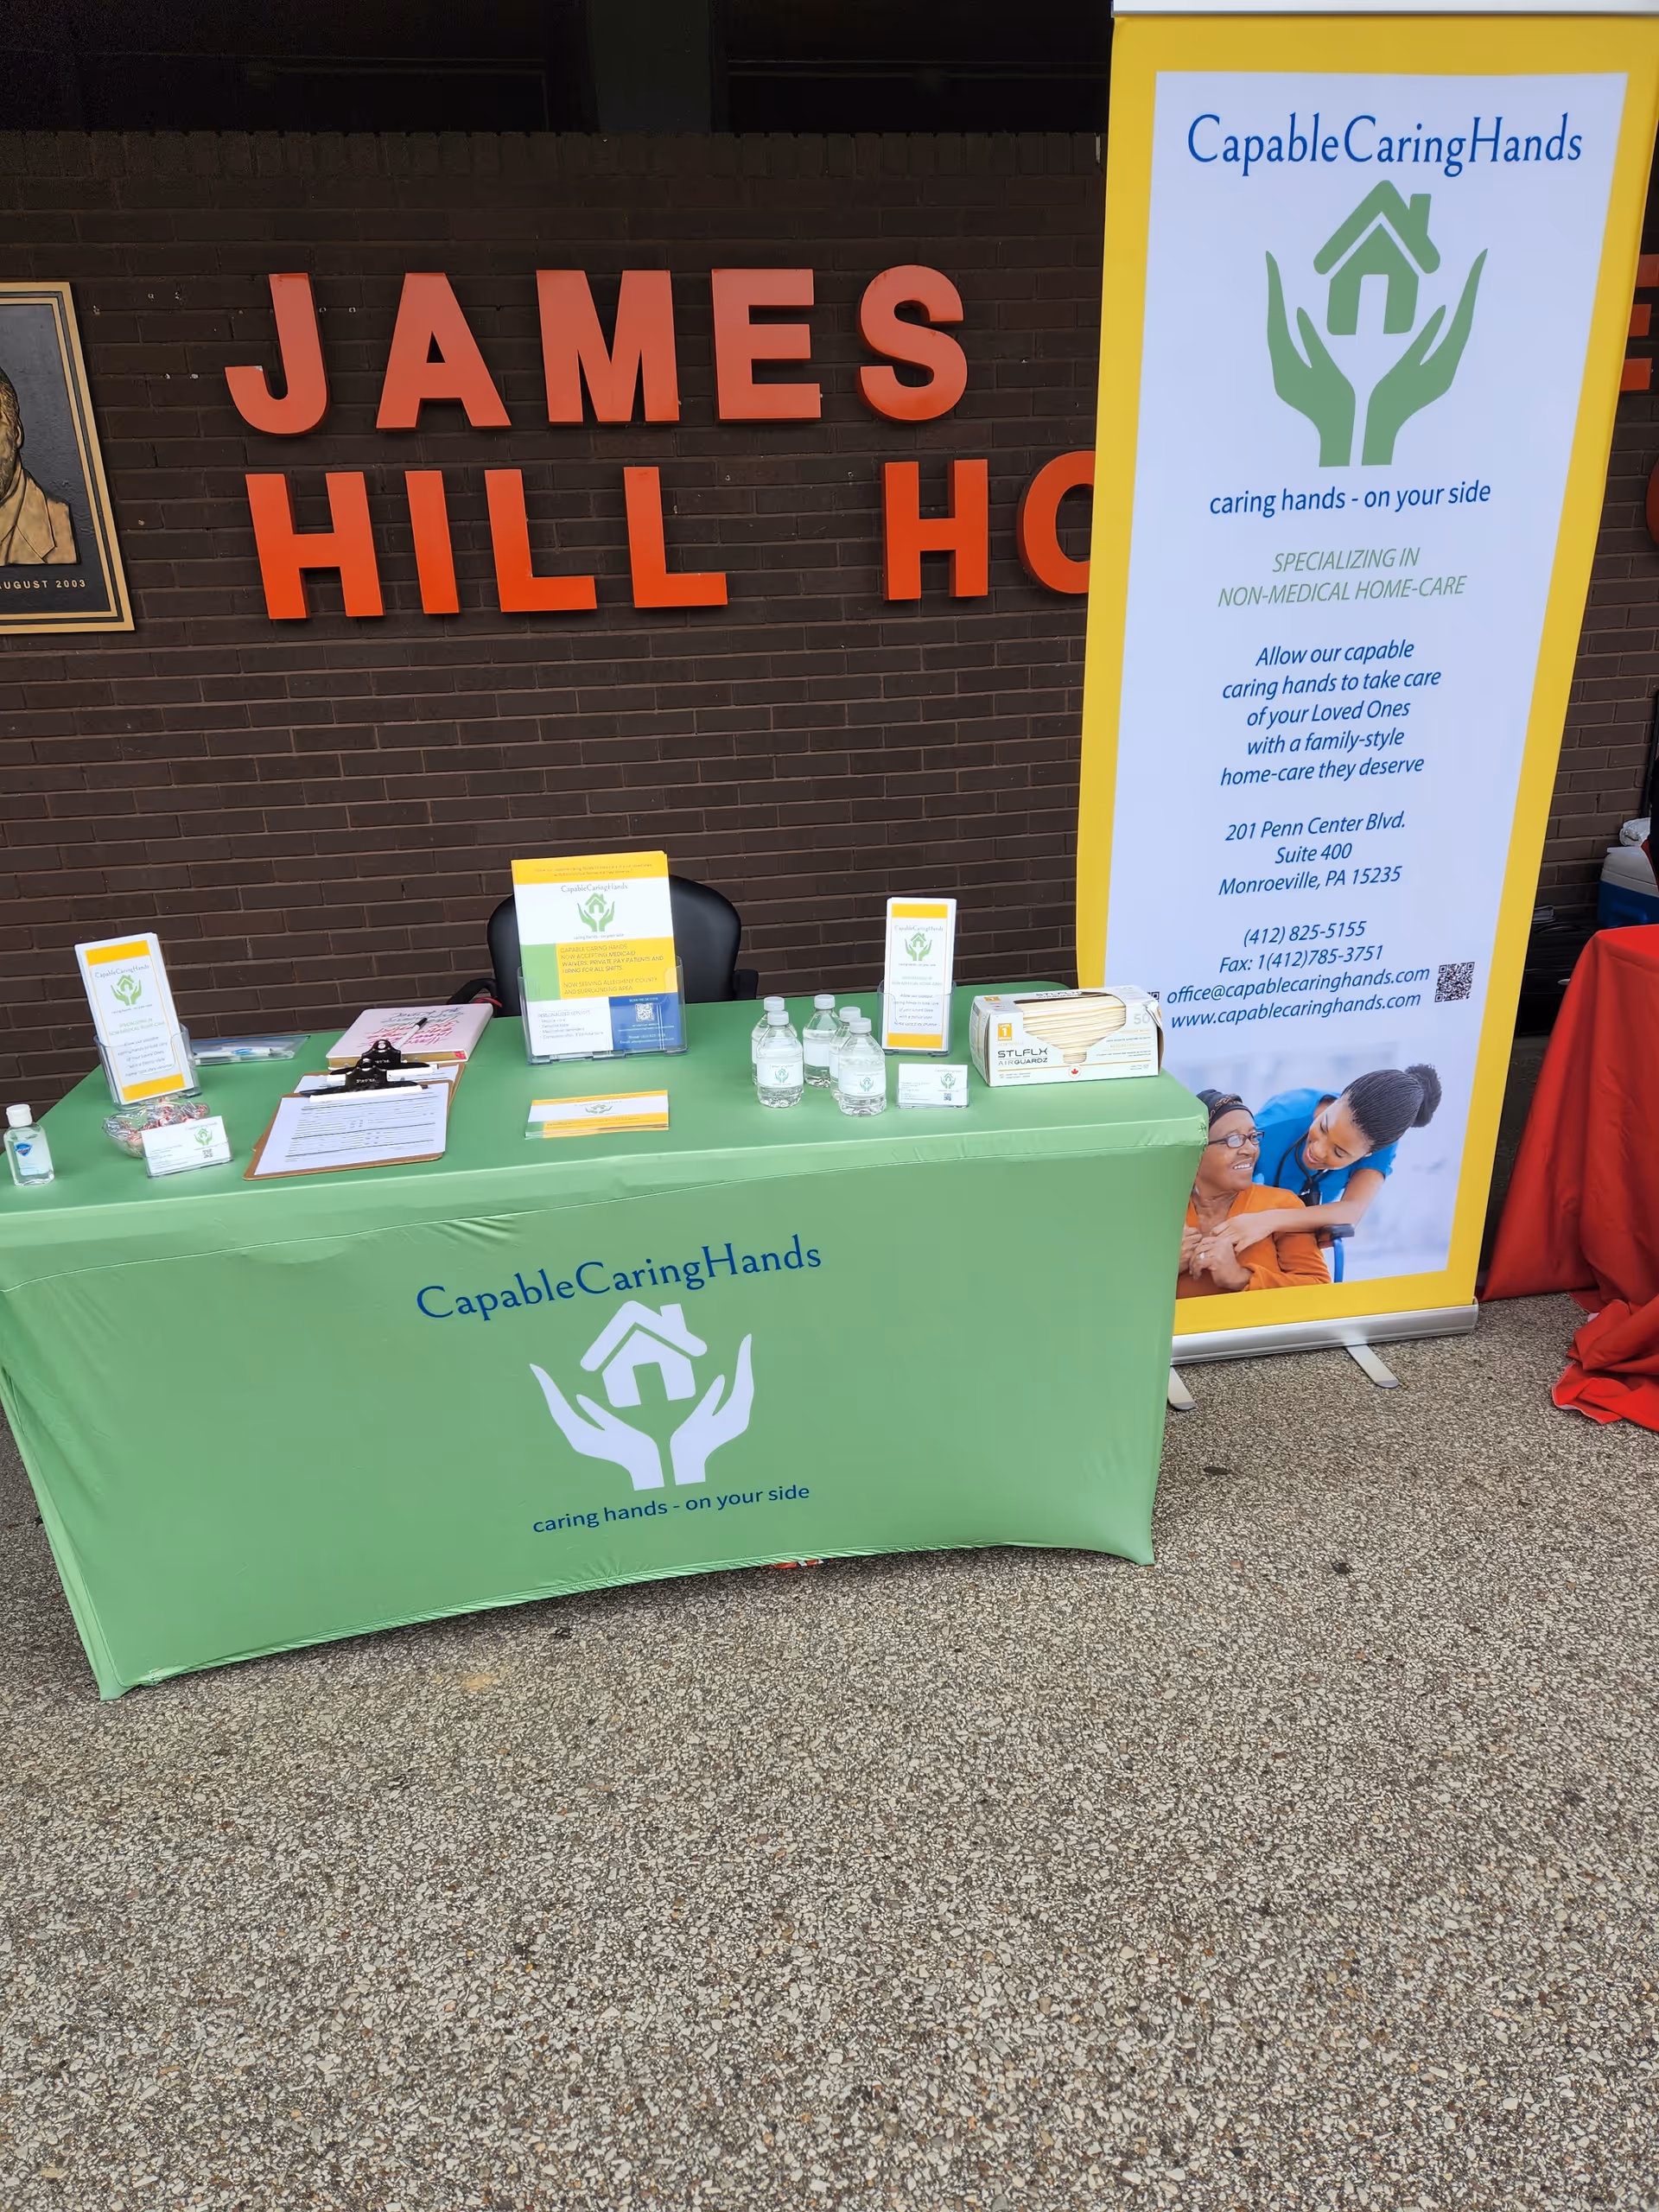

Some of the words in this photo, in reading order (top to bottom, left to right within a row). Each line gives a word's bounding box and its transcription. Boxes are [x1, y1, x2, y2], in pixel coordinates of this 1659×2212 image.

[1187, 112, 1583, 178] CapableCaringHands
[225, 264, 968, 435] JAMES
[1210, 488, 1276, 518] caring
[1281, 486, 1346, 511] hands
[1363, 490, 1390, 508] on
[1395, 487, 1445, 513] your
[1448, 480, 1491, 503] side
[245, 467, 728, 620] HILL
[1272, 549, 1397, 573] SPECIALIZING
[1398, 547, 1421, 567] IN
[0, 580, 48, 589] UGUST
[55, 579, 86, 588] 2003
[1217, 582, 1351, 607] NON-MEDICAL
[1355, 575, 1468, 601] HOME-CARE
[1255, 645, 1307, 667] Allow
[1310, 647, 1342, 664] our
[1344, 639, 1415, 664] capable
[1222, 678, 1279, 701] caring
[1281, 673, 1338, 694] hands
[1340, 674, 1359, 690] to
[1362, 670, 1402, 689] take
[1403, 671, 1442, 688] care
[1247, 706, 1269, 727] of
[1266, 708, 1310, 730] your
[1311, 700, 1365, 721] Loved
[1366, 700, 1412, 719] Ones
[1247, 735, 1286, 755] with
[1289, 739, 1300, 753] a
[1304, 728, 1405, 753] family-style
[1220, 765, 1315, 786] home-care
[1319, 760, 1357, 782] they
[1358, 757, 1425, 776] deserve
[1224, 823, 1256, 842] 201
[1260, 820, 1304, 839] Penn
[1306, 816, 1364, 836] Center
[1365, 810, 1406, 830] Blvd.
[1274, 846, 1318, 864] Suite
[1320, 842, 1353, 861] 400
[561, 881, 628, 893] CapableCaringHands
[1217, 872, 1322, 896] Monroeville,
[1325, 869, 1346, 887] PA
[1351, 866, 1402, 886] 15235
[1243, 926, 1287, 948] (412)
[1288, 920, 1367, 942] 825-5155
[1218, 955, 1253, 974] Fax:
[1257, 944, 1384, 972] 1(412)785-3751
[1166, 966, 1431, 1005] office@capablecaringhands.com
[1171, 992, 1421, 1029] www.capablecaringhands.com
[1001, 1027, 1009, 1037] 1
[997, 1046, 1048, 1058] STLFLX
[997, 1057, 1048, 1066] AIRGUARDZ
[416, 1234, 823, 1322] CapableCaringHands
[532, 1510, 601, 1534] caring
[604, 1500, 668, 1522] hands
[685, 1496, 712, 1511] on
[716, 1488, 765, 1510] your
[767, 1484, 810, 1502] side
